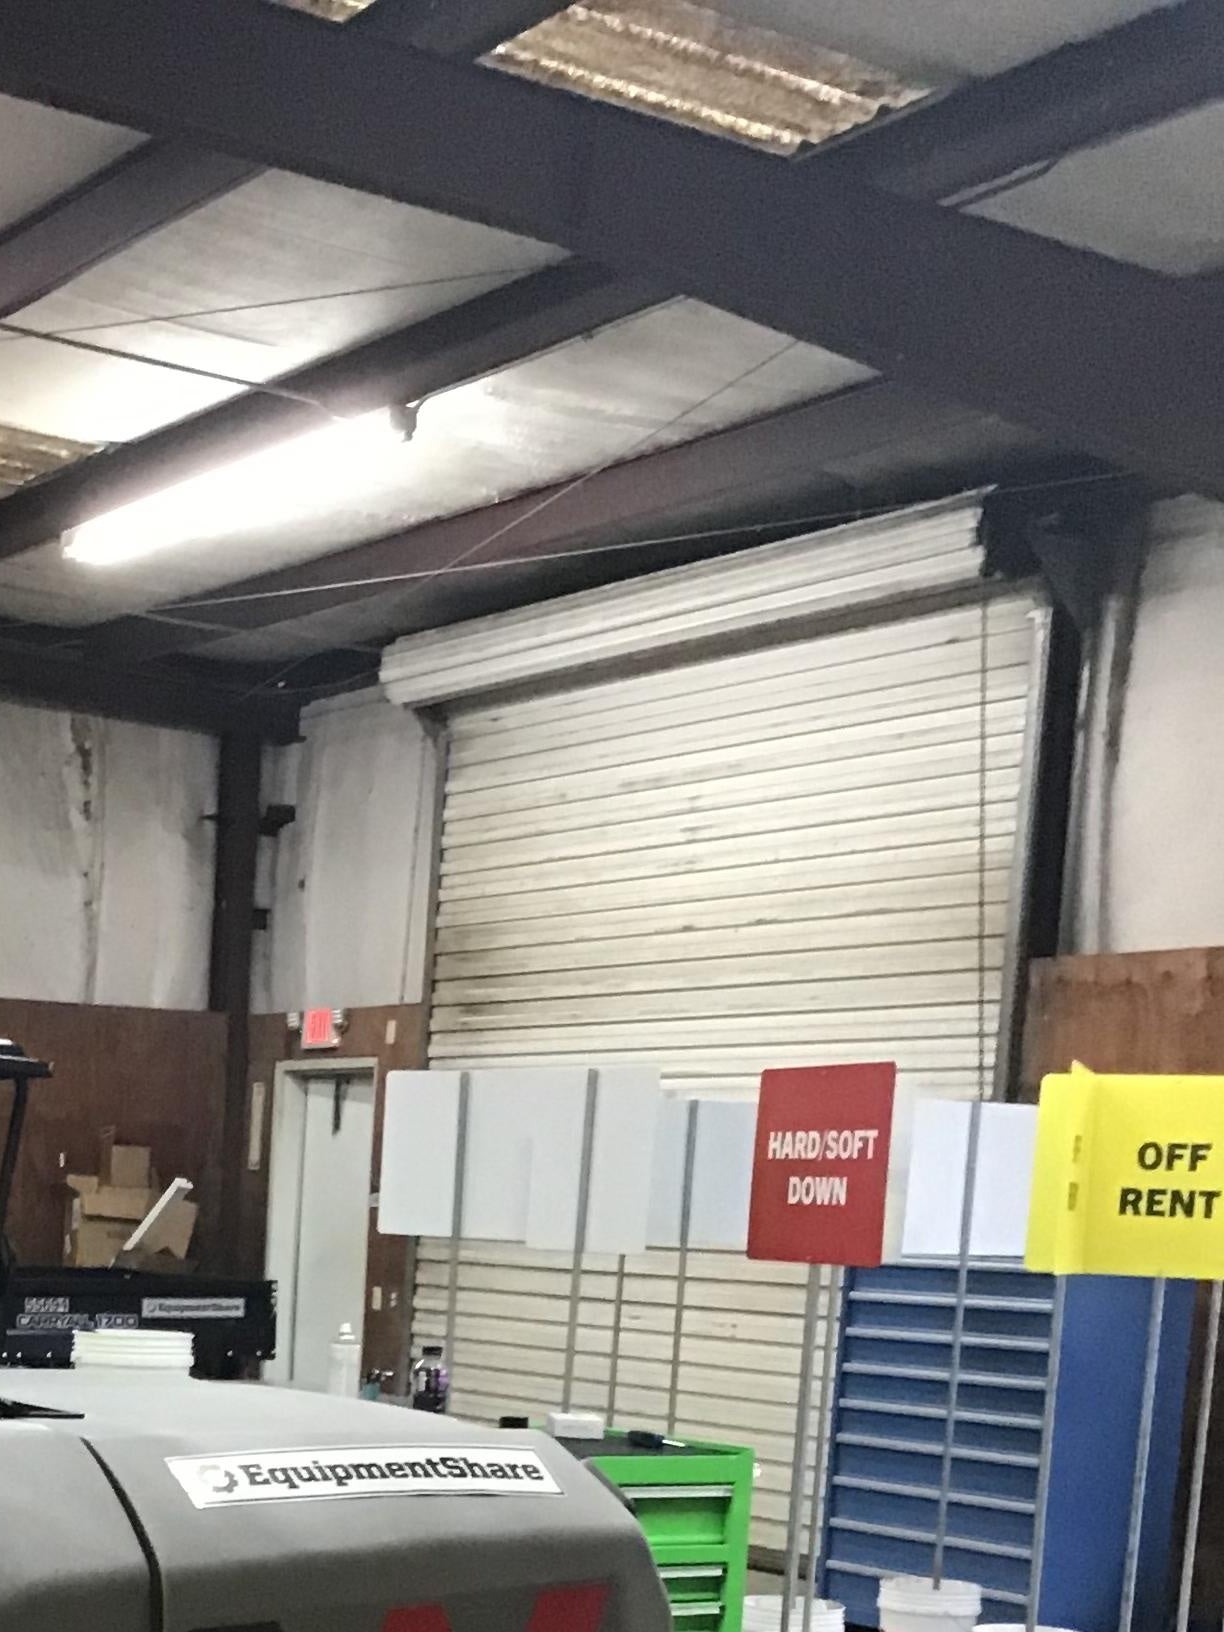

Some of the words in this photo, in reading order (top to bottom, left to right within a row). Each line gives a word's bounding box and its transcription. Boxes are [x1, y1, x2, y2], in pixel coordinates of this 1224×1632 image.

[768, 1129, 878, 1160] HARD/SOFT
[1137, 1141, 1213, 1172] OFF
[787, 1176, 848, 1206] DOWN
[1118, 1187, 1223, 1219] RENT
[96, 1313, 139, 1329] 1700
[237, 1456, 545, 1490] EquipmentShare
